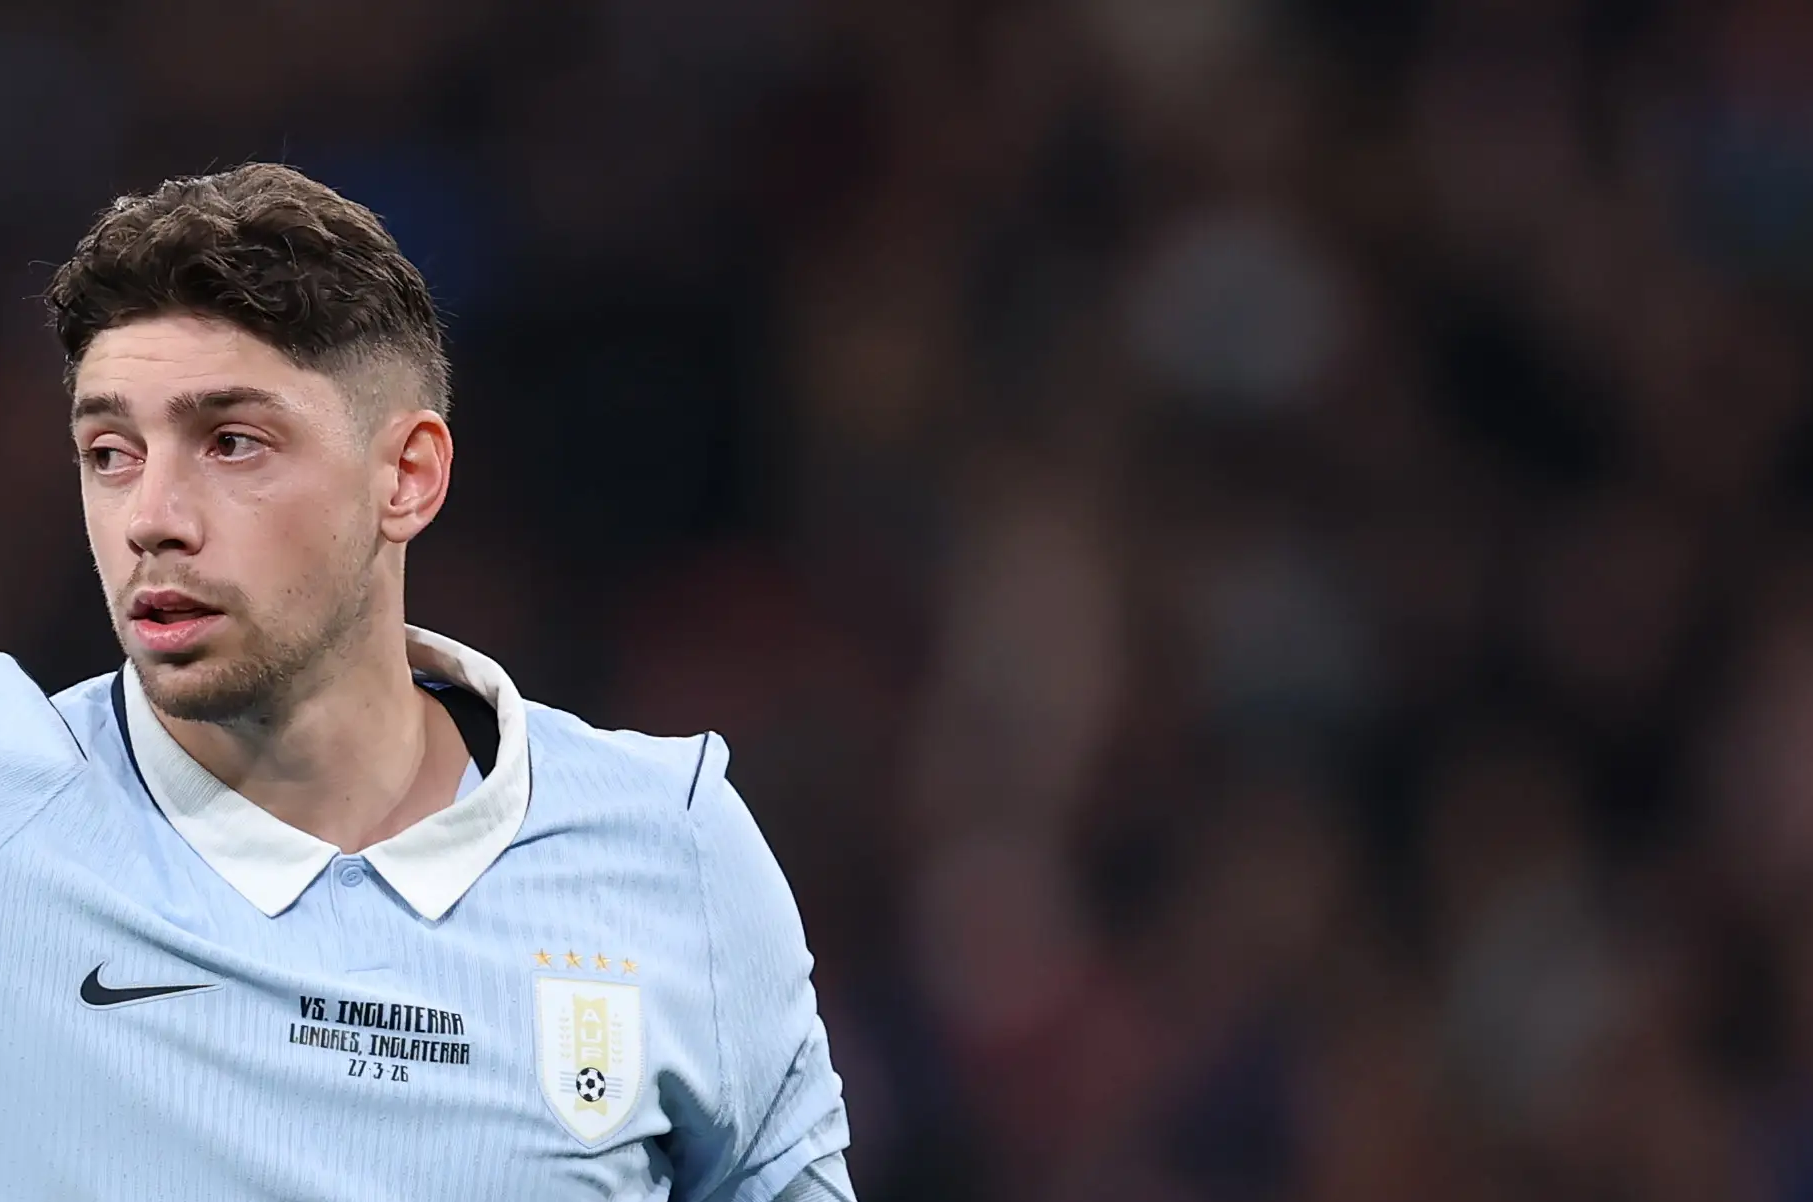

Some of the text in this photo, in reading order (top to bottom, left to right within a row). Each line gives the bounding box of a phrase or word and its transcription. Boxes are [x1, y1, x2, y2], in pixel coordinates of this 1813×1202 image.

[299, 995, 464, 1035] VS. INGLATERRA
[580, 1008, 604, 1063] AUF
[289, 1023, 470, 1065] LONDRES, INGLATERRA
